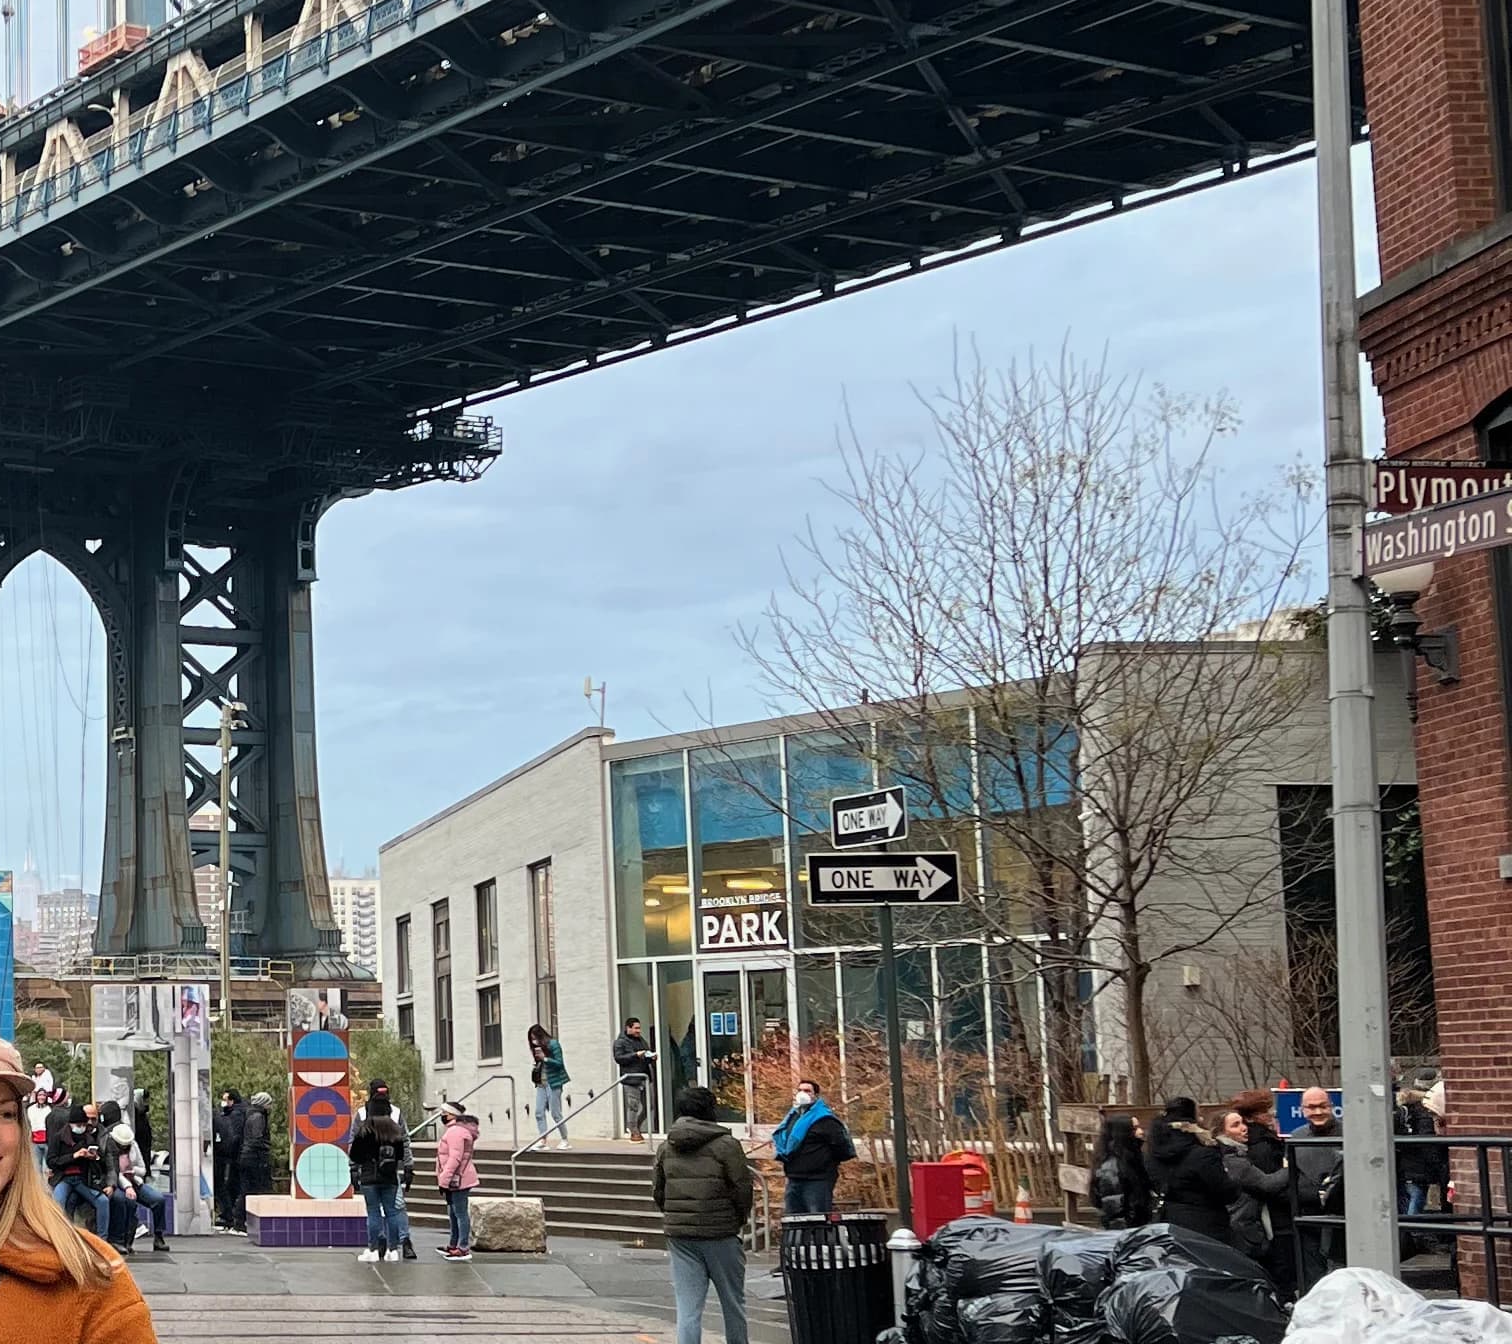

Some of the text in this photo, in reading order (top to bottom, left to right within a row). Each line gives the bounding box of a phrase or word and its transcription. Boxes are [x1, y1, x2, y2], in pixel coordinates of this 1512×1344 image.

[1365, 510, 1496, 566] Washington
[842, 806, 888, 831] ONE WAY
[832, 869, 936, 888] ONE WAY
[701, 892, 781, 907] BROOKLYN BRIDGE
[702, 911, 784, 946] PARK
